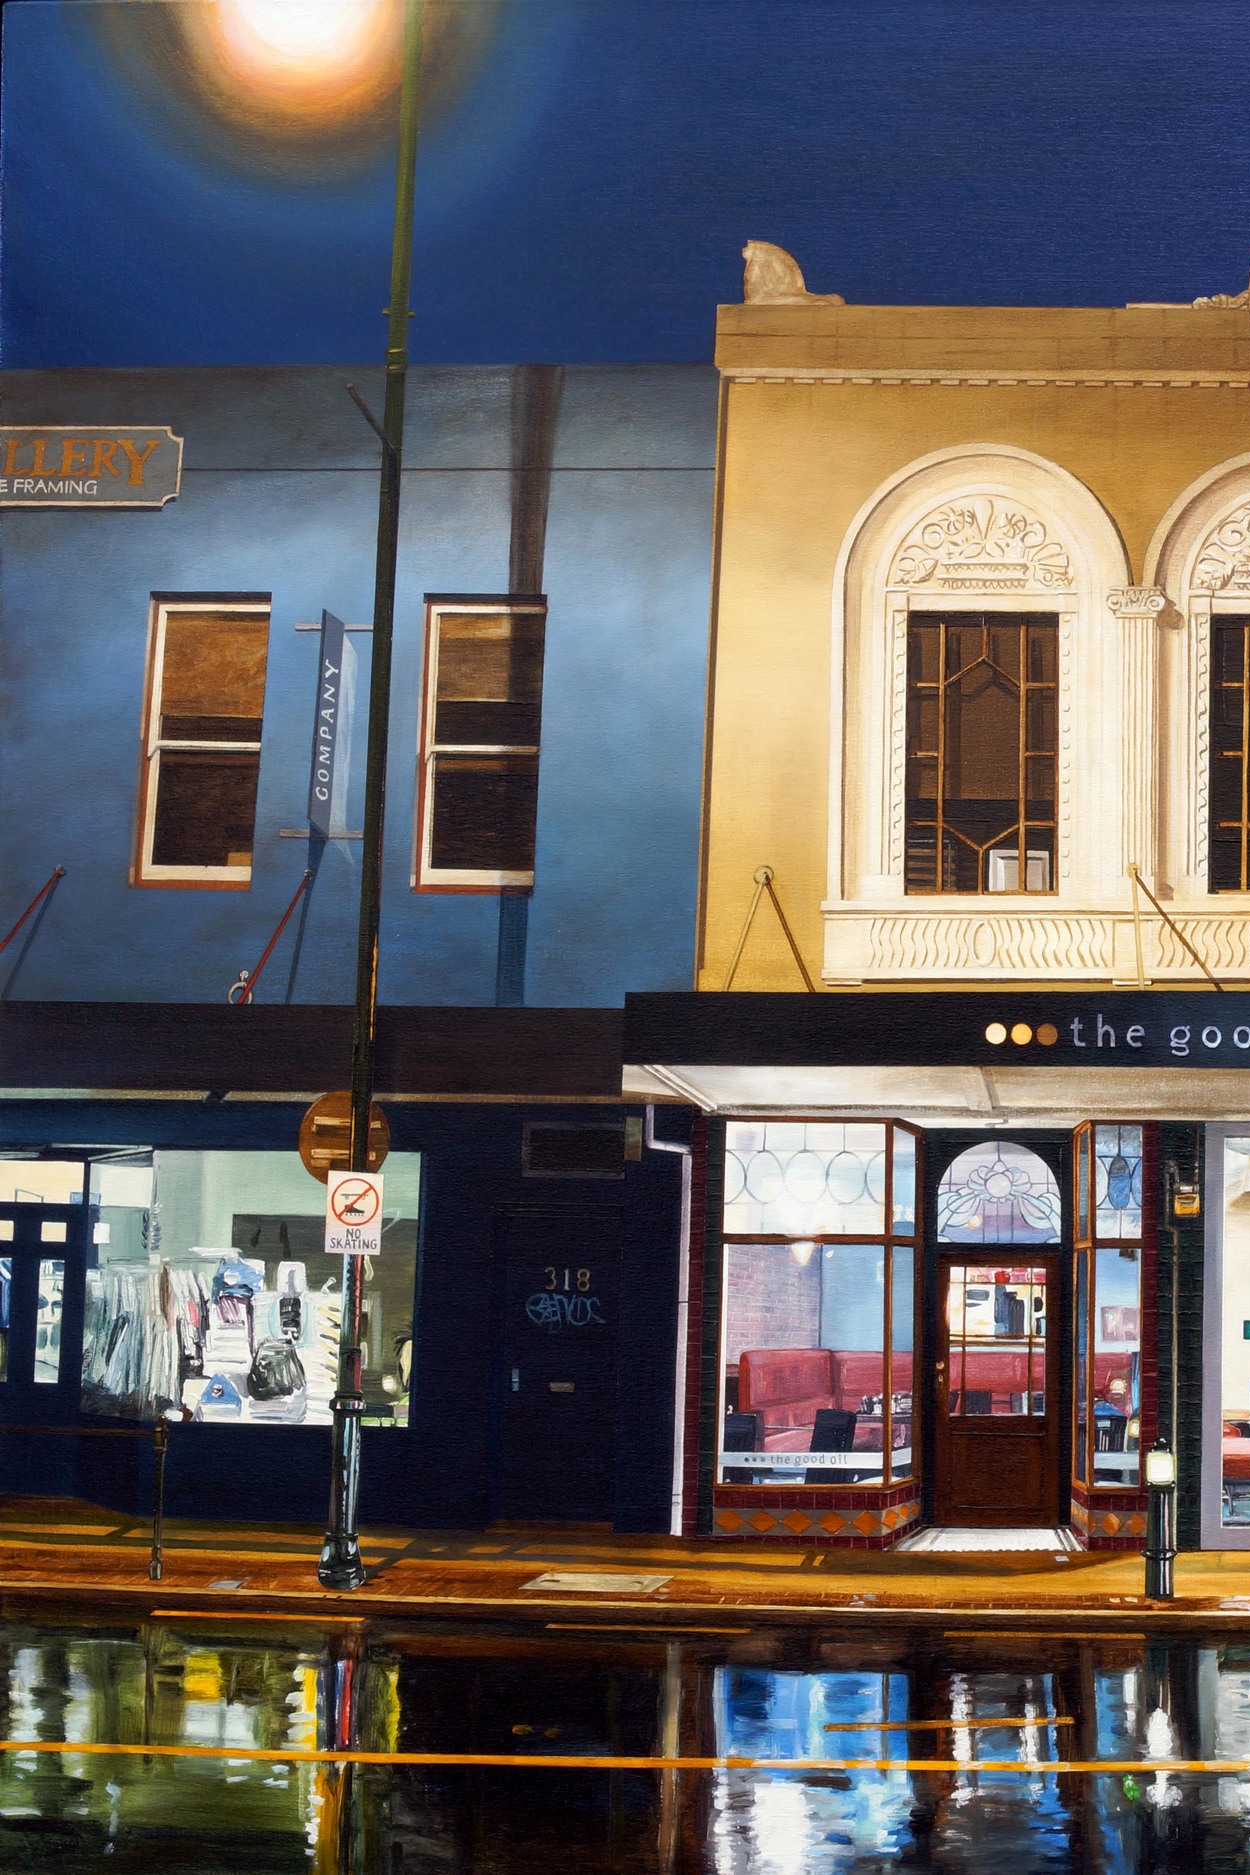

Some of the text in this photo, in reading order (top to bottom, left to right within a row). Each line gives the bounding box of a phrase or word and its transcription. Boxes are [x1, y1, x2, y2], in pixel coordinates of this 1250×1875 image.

[3, 439, 161, 486] LLERY
[13, 478, 98, 495] FRAMING
[315, 659, 339, 801] COMPANY
[1070, 1014, 1146, 1048] the
[329, 1237, 378, 1250] SKATING
[345, 1228, 362, 1239] NO
[544, 1266, 591, 1292] 318
[770, 1454, 848, 1466] the good oil
